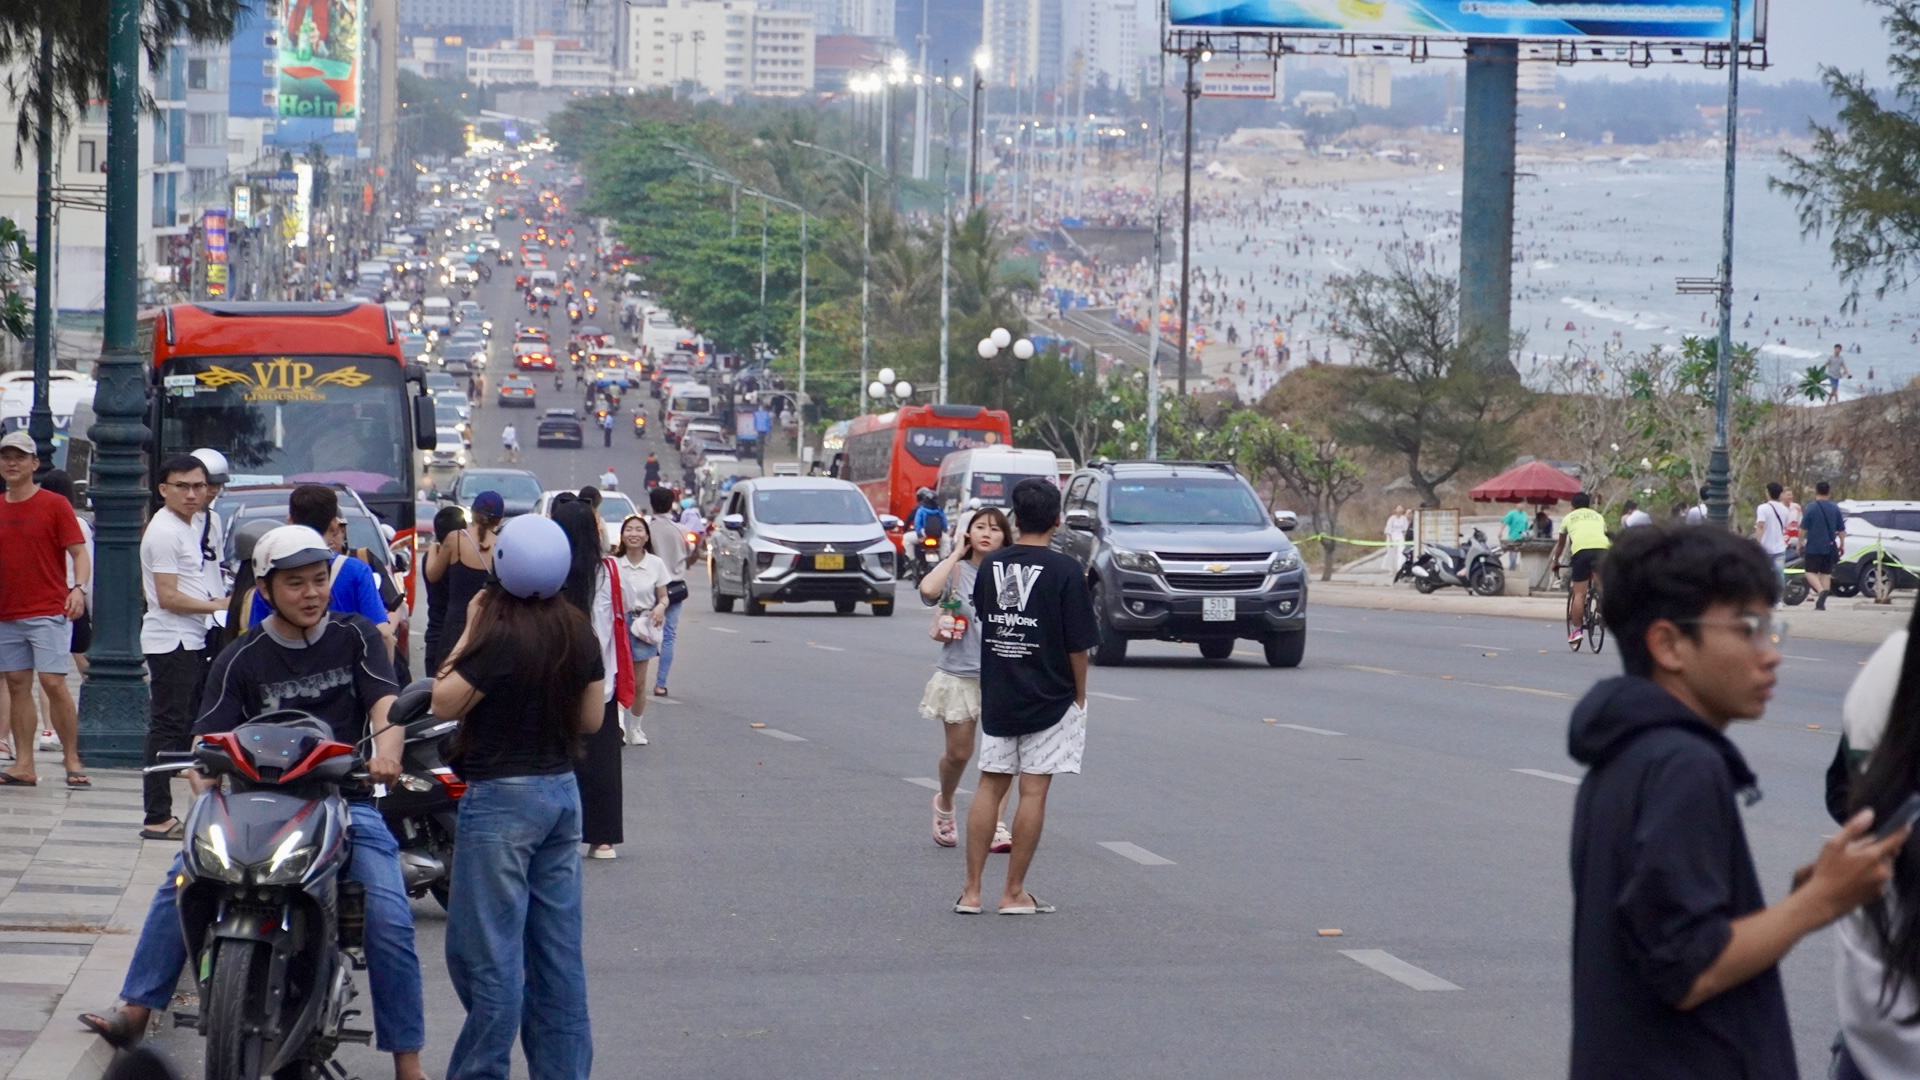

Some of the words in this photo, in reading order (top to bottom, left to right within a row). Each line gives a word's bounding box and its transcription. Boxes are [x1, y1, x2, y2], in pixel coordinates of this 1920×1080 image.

[252, 361, 314, 390] VIP
[243, 392, 326, 402] LIMOUSINES
[1210, 598, 1228, 609] 51D
